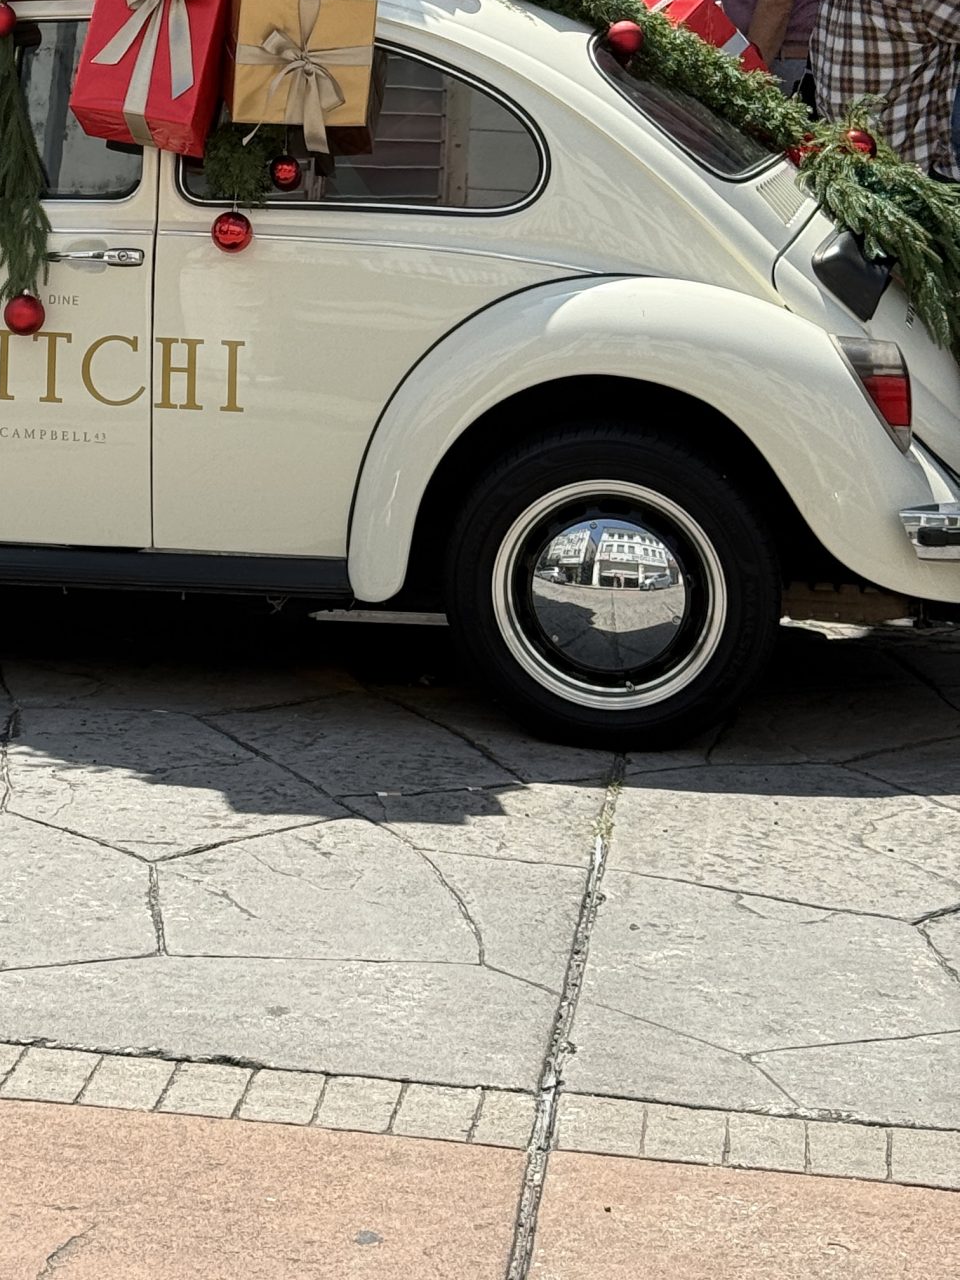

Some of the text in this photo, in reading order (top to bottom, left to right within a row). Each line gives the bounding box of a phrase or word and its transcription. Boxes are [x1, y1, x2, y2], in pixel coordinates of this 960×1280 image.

[48, 294, 80, 306] DINE
[0, 426, 91, 442] CAMPBELL
[94, 432, 106, 440] 43
